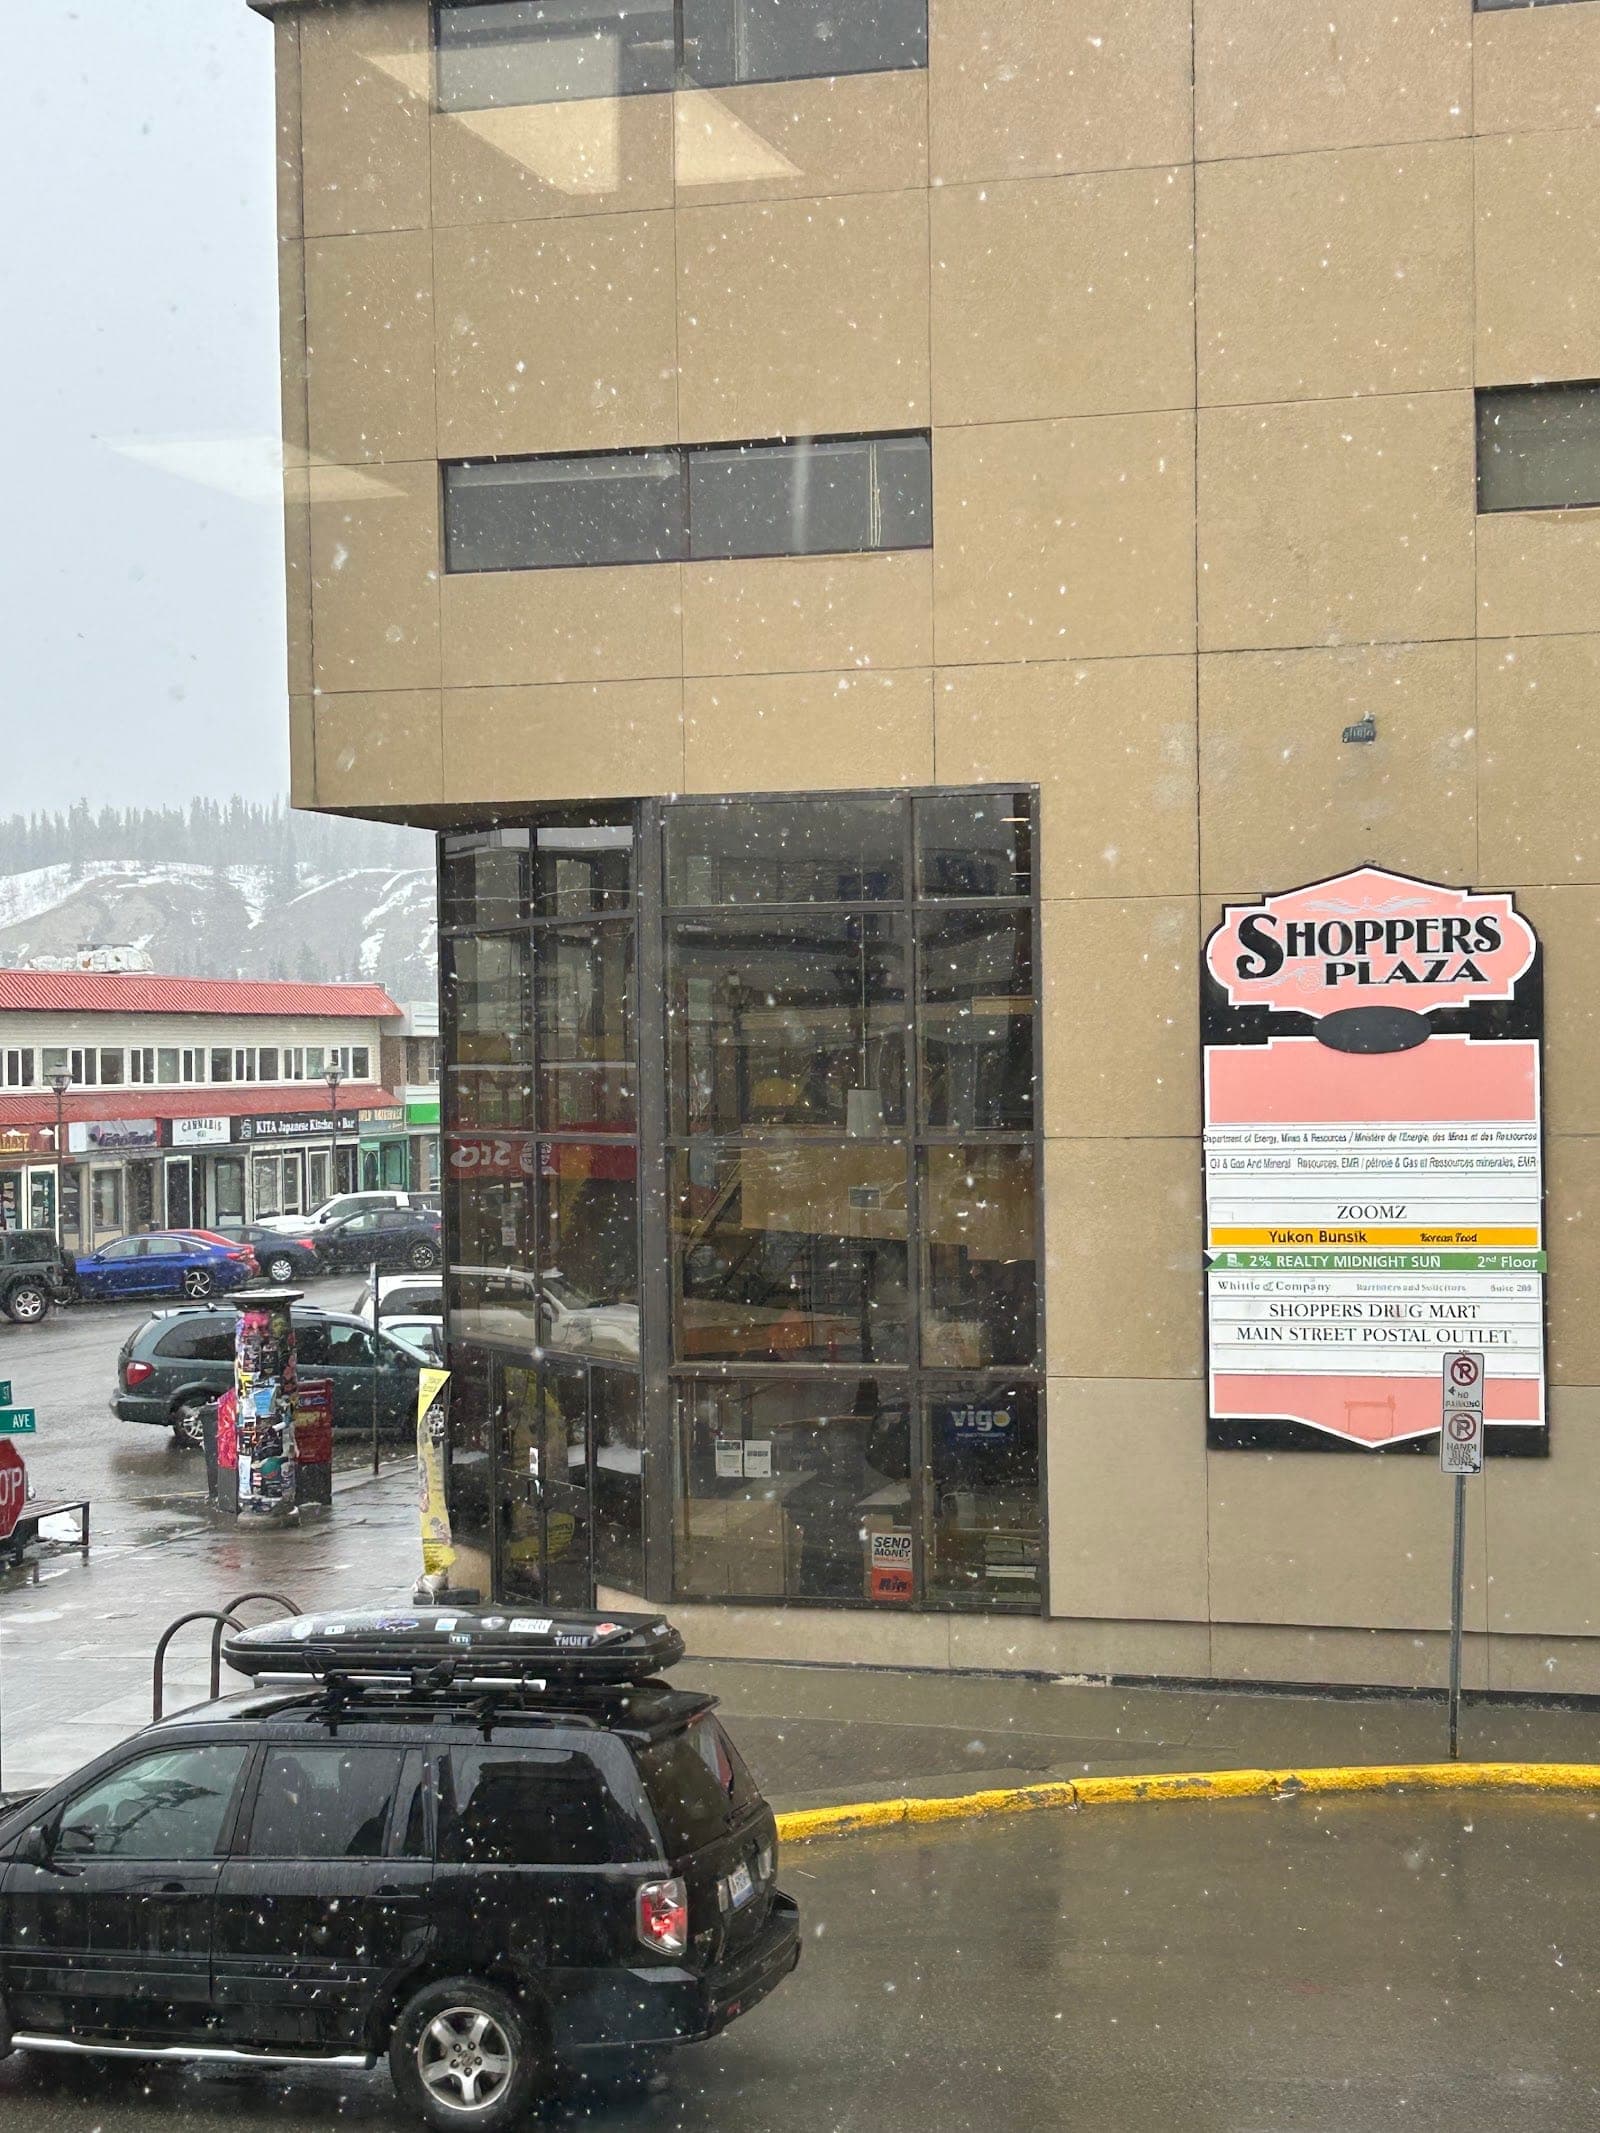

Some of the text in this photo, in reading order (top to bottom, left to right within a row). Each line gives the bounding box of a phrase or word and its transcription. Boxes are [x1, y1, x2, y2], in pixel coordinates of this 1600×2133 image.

[1236, 913, 1502, 980] SHOPPERS
[1325, 959, 1488, 986] PLAZA
[181, 1119, 223, 1132] CANNABIS
[256, 1120, 277, 1134] KITA
[278, 1120, 308, 1134] Japanese
[342, 1117, 355, 1129] Bar
[1203, 1133, 1242, 1145] Department
[1244, 1133, 1252, 1143] of
[1311, 1133, 1347, 1143] Resources
[1222, 1158, 1228, 1169] &
[1230, 1158, 1245, 1169] Gas
[1264, 1158, 1291, 1169] Mineral
[1337, 1205, 1407, 1219] ZOOMZ
[1269, 1230, 1478, 1243] Yukon Bunsik Korean Food
[1249, 1255, 1272, 1267] 2%
[1276, 1255, 1329, 1268] REALTY
[1334, 1255, 1409, 1268] MIDNIGHT
[1411, 1255, 1441, 1268] SUN
[1477, 1255, 1497, 1268] 2nd
[1501, 1256, 1538, 1268] Floor
[1218, 1280, 1260, 1290] Whittle
[1262, 1281, 1274, 1292] &
[1276, 1280, 1331, 1293] Company
[1402, 1283, 1420, 1292] and
[1269, 1303, 1480, 1319] SHOPPERS DRUG MART
[1237, 1327, 1512, 1344] MAIN STREET POSTAL OUTLET
[1445, 1400, 1481, 1408] PARKING
[12, 1413, 32, 1428] AVE
[950, 1404, 1011, 1432] vigo
[874, 1536, 911, 1549] SEND
[874, 1548, 911, 1558] MONEY
[450, 1635, 469, 1644] YETI
[554, 1635, 588, 1647] THULE
